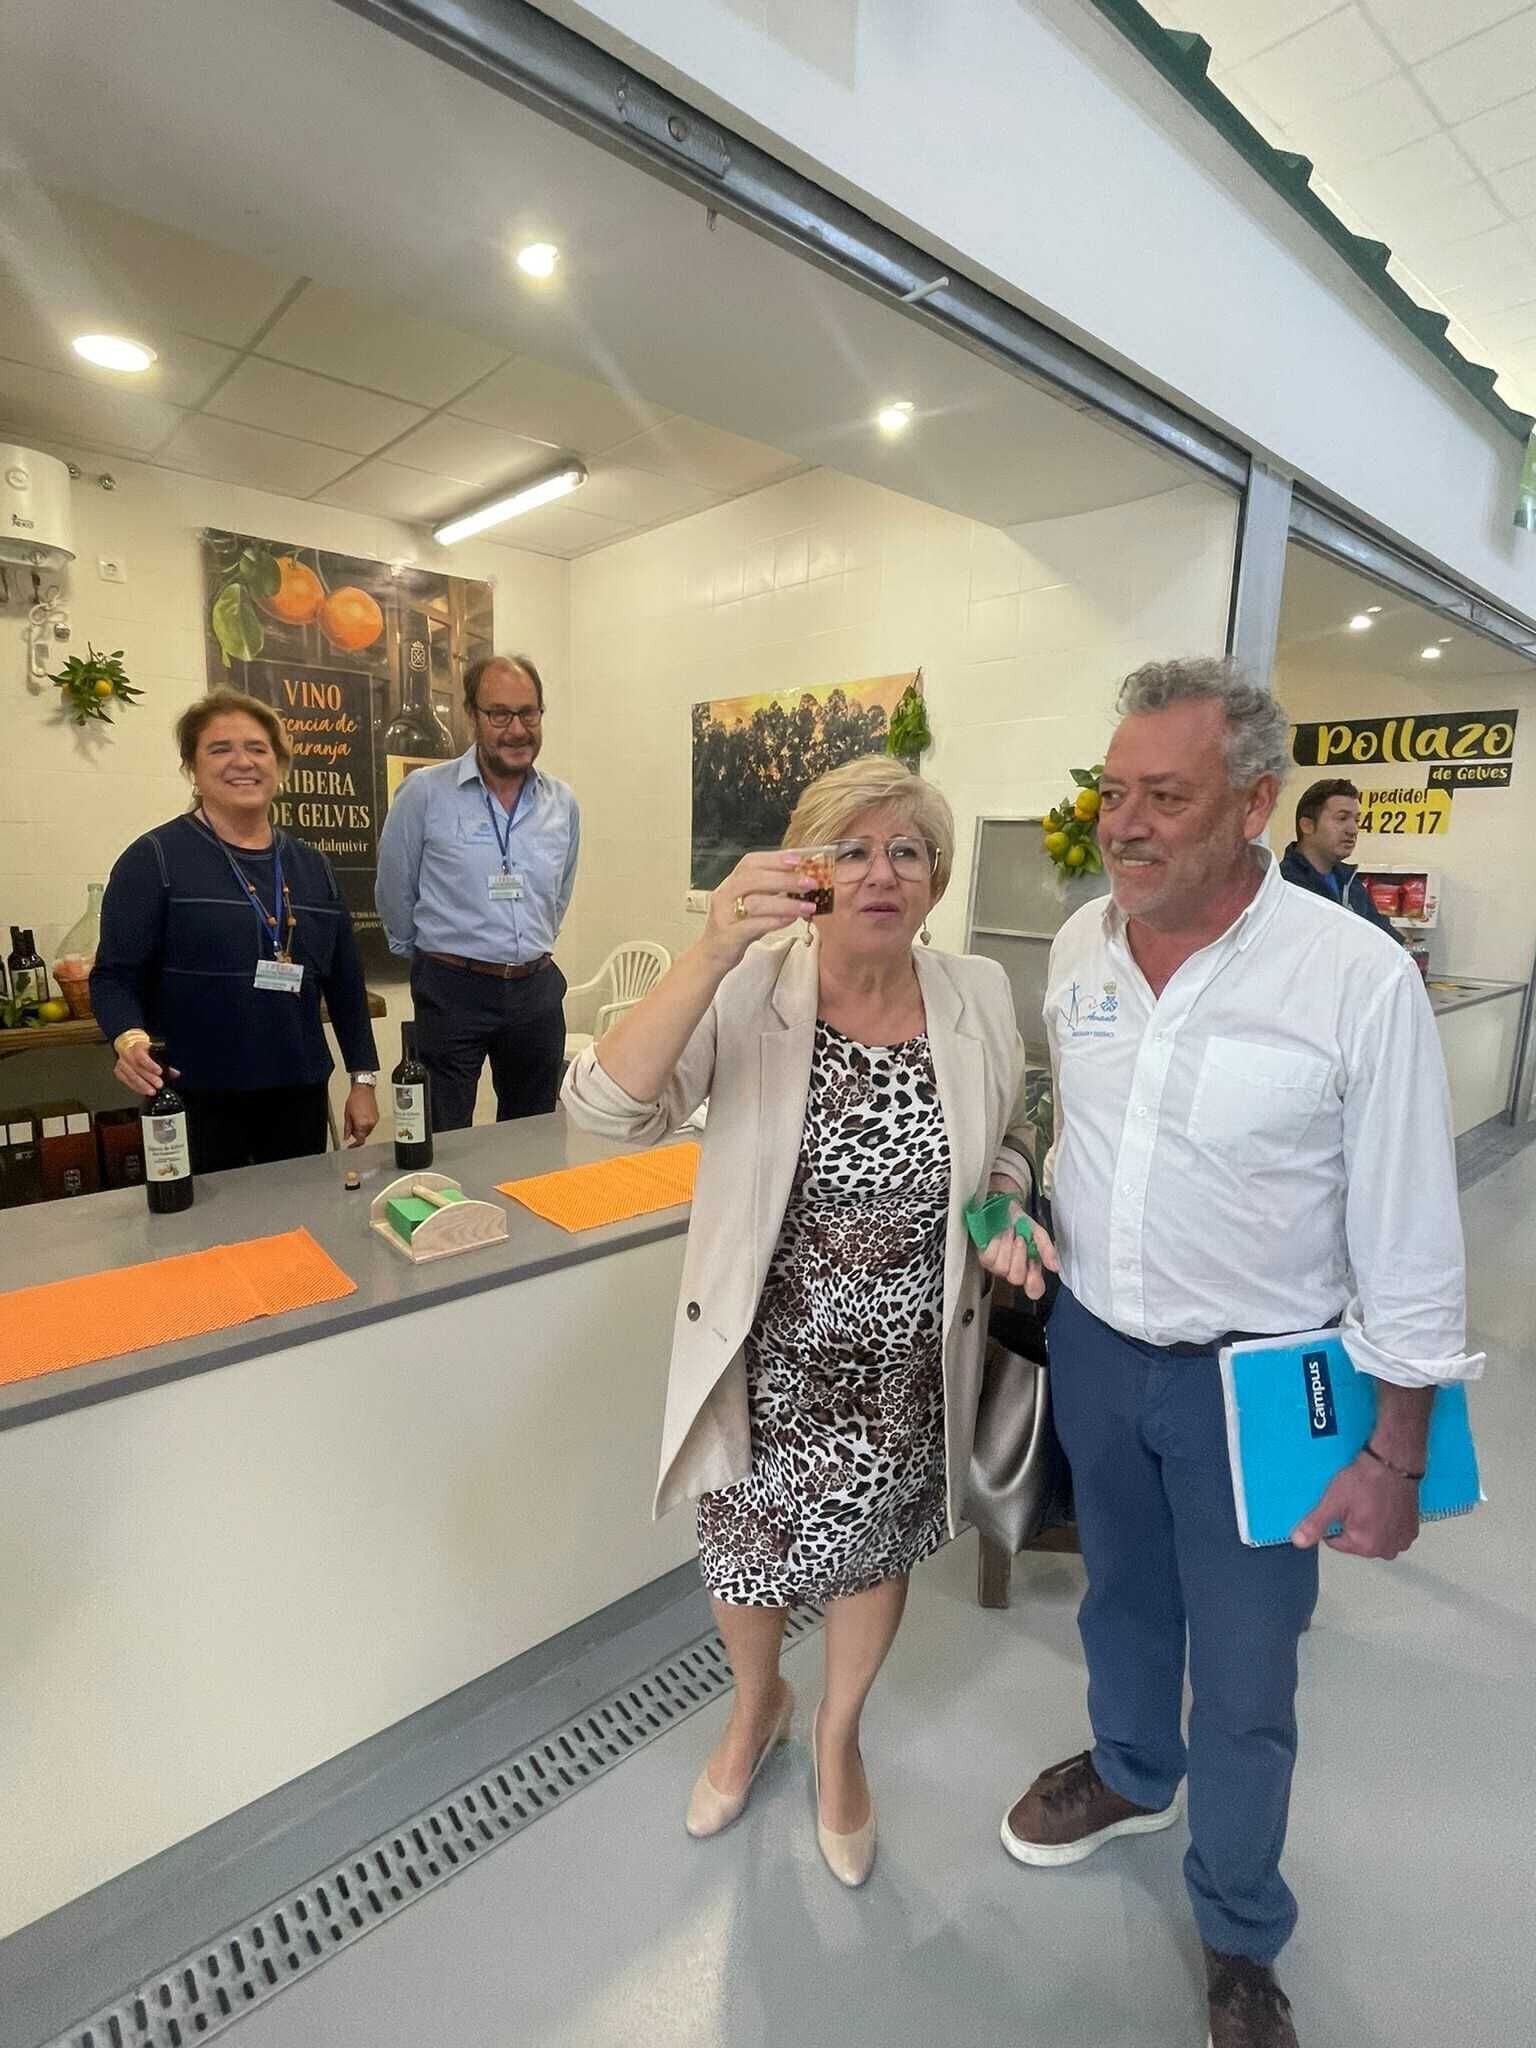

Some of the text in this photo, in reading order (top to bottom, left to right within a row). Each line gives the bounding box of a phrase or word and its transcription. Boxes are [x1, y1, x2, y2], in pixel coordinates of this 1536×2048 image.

[283, 679, 342, 711] VINO
[335, 712, 358, 733] de
[1432, 765, 1508, 781] de Gelves
[1368, 787, 1428, 808] pedido!
[298, 802, 371, 829] GELVES
[1357, 810, 1442, 834] 4 22 17
[1309, 1361, 1327, 1430] Campus
